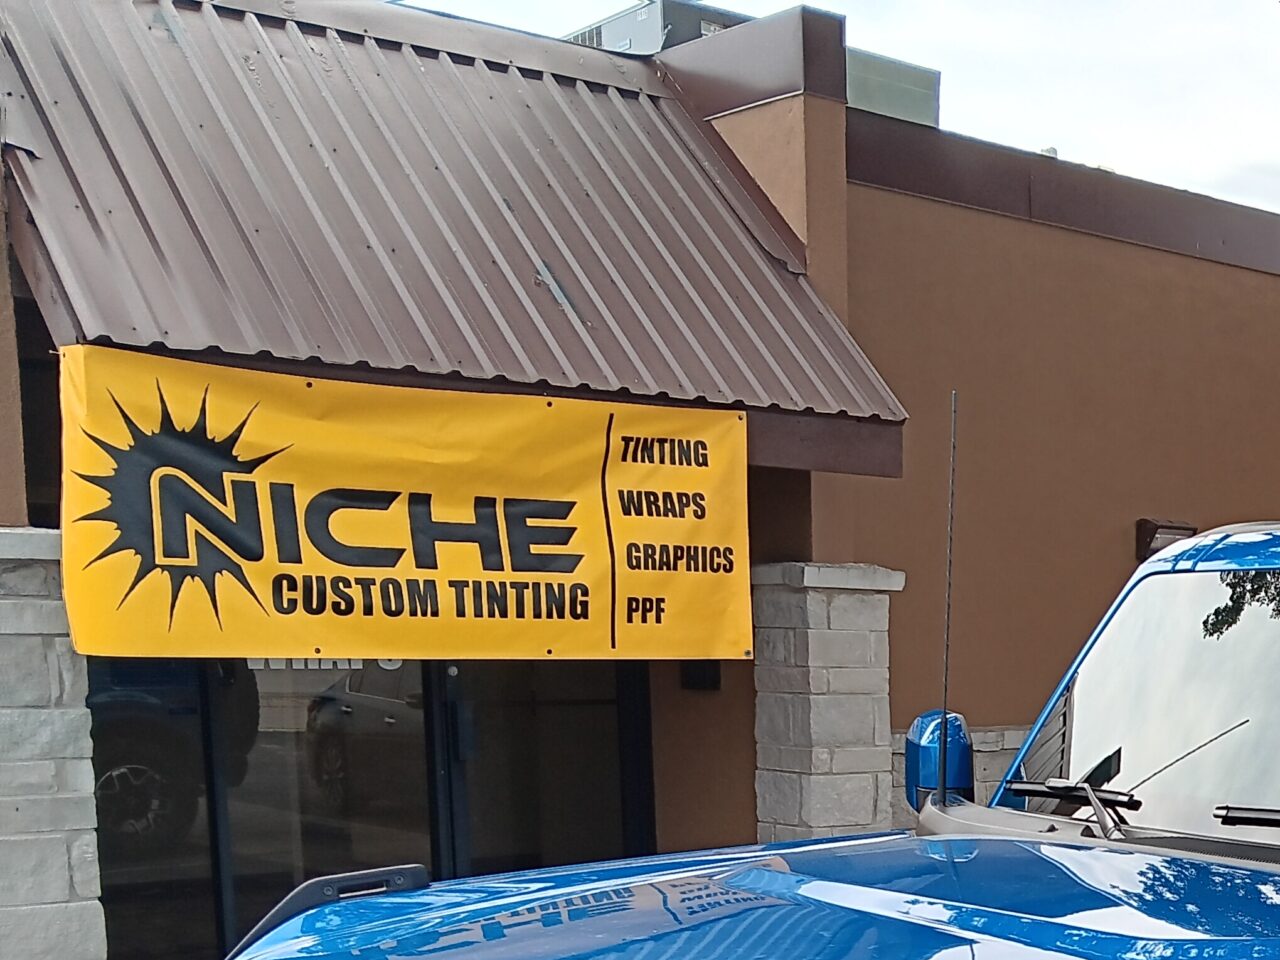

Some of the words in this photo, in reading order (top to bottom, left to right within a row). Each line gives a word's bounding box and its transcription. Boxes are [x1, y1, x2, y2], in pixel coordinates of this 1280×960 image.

[620, 435, 709, 468] TINTING
[617, 489, 706, 520] WRAPS
[157, 472, 585, 573] NICHE
[626, 542, 734, 574] GRAPHICS
[272, 573, 439, 618] CUSTOM
[448, 579, 590, 620] TINTING
[626, 596, 666, 625] PPF
